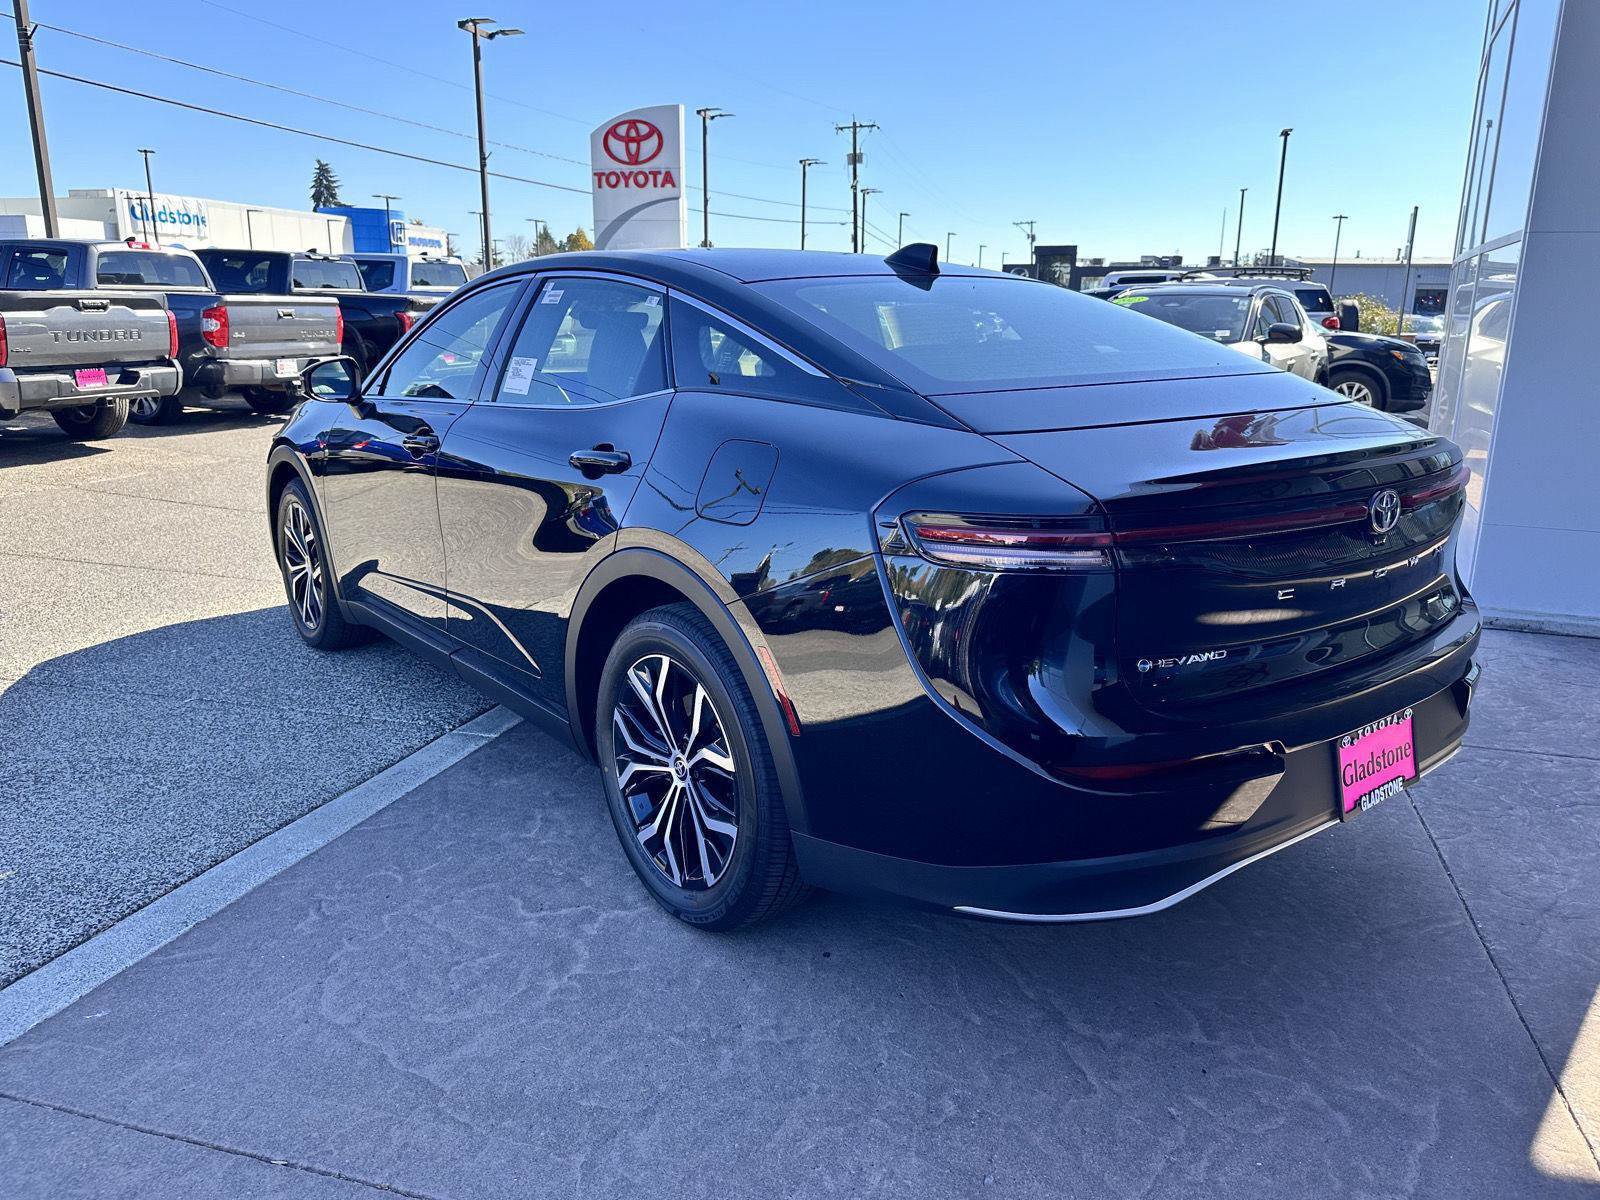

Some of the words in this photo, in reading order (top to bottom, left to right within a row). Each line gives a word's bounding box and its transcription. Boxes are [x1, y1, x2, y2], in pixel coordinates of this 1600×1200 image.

[593, 170, 677, 189] TOYOTA
[48, 328, 142, 344] TUNDRA
[1187, 649, 1227, 665] AWD
[1357, 714, 1398, 740] TOYOTA
[1342, 741, 1411, 787] Gladstone
[1360, 776, 1404, 812] GLADSTONE
